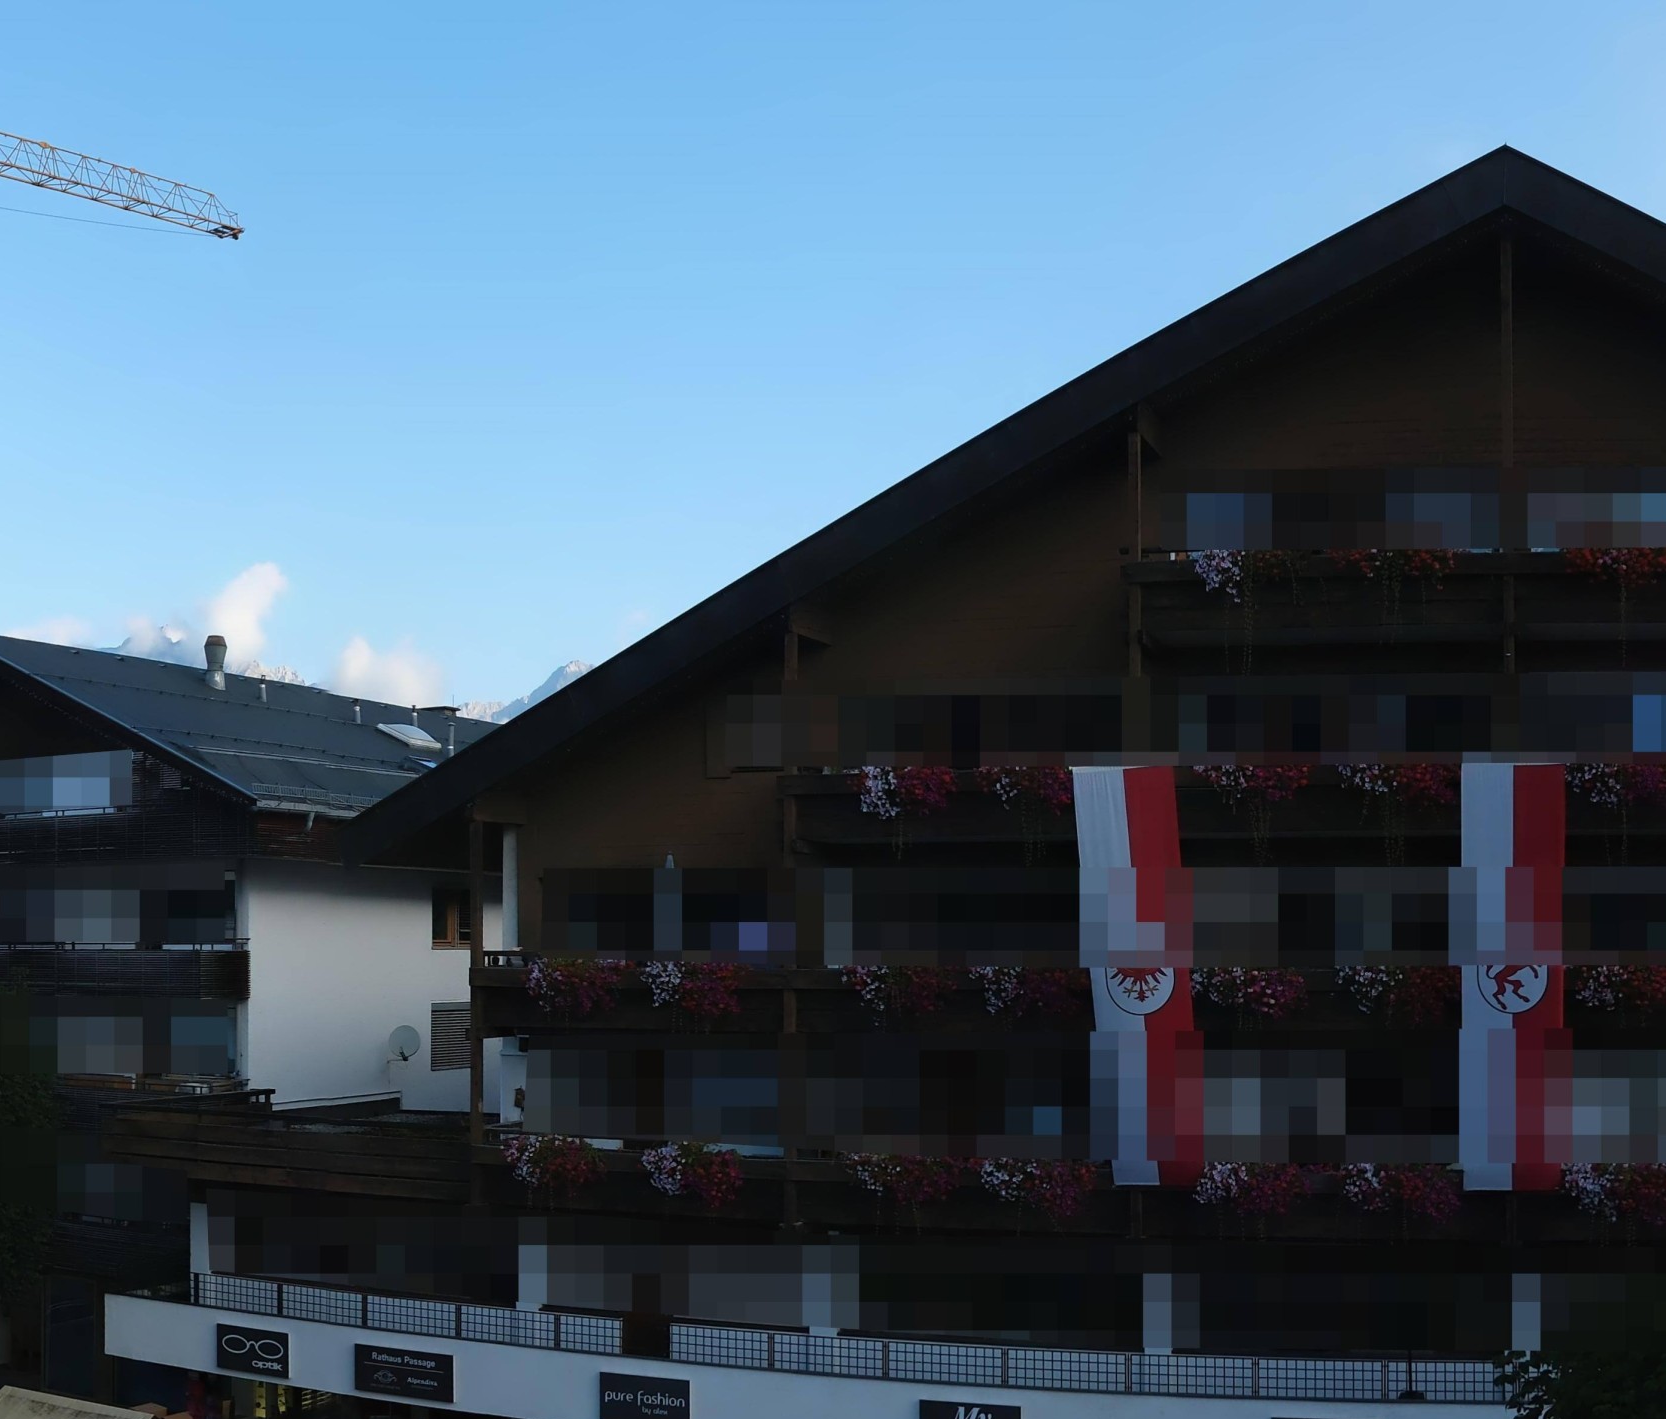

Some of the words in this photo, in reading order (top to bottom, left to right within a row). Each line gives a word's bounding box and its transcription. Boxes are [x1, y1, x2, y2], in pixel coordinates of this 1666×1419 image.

[251, 1359, 282, 1371] optik
[372, 1351, 402, 1363] Rathaus
[404, 1355, 436, 1369] Passage
[604, 1390, 633, 1403] pure
[637, 1390, 685, 1407] fashion
[642, 1406, 651, 1415] by
[653, 1407, 668, 1416] alex
